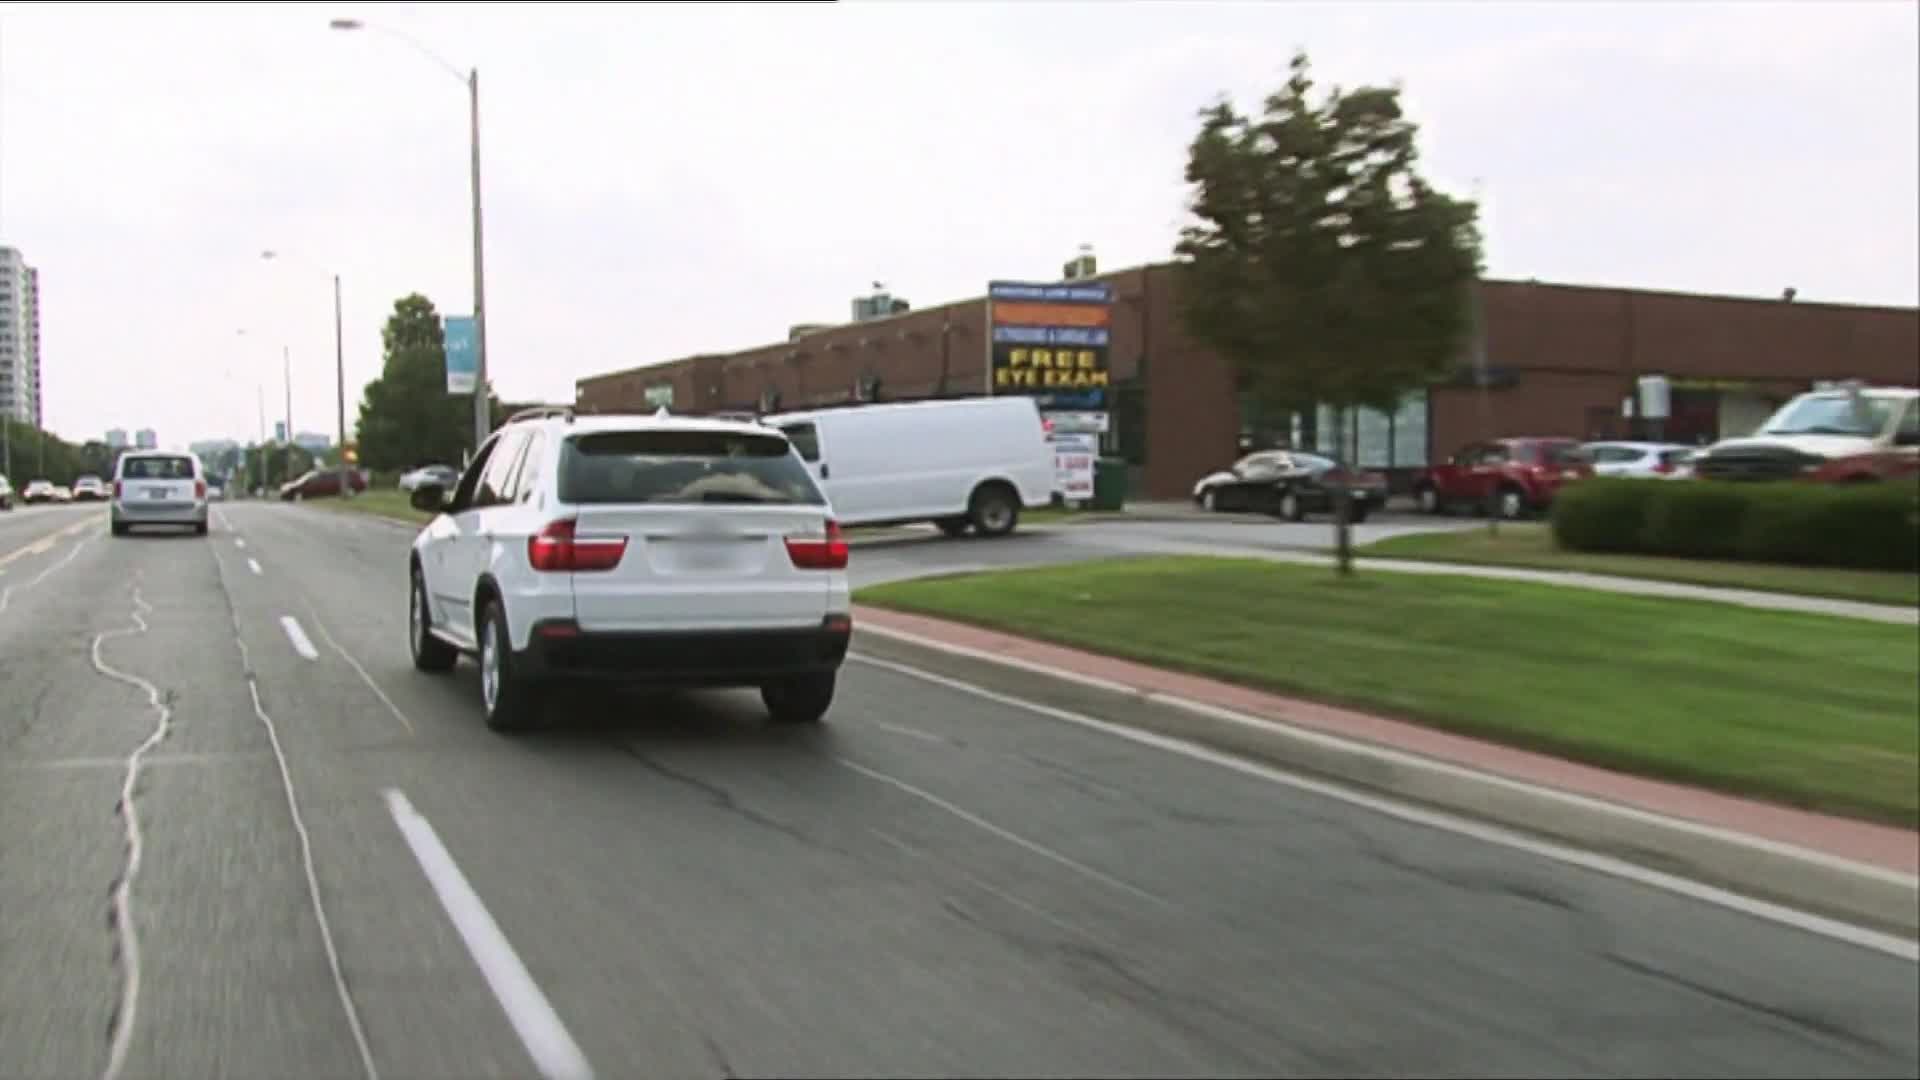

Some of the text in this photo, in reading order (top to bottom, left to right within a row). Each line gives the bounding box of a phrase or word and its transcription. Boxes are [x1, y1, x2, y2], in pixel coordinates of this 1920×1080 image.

[1010, 350, 1096, 368] FREE
[997, 368, 1108, 386] EYE EXAM
